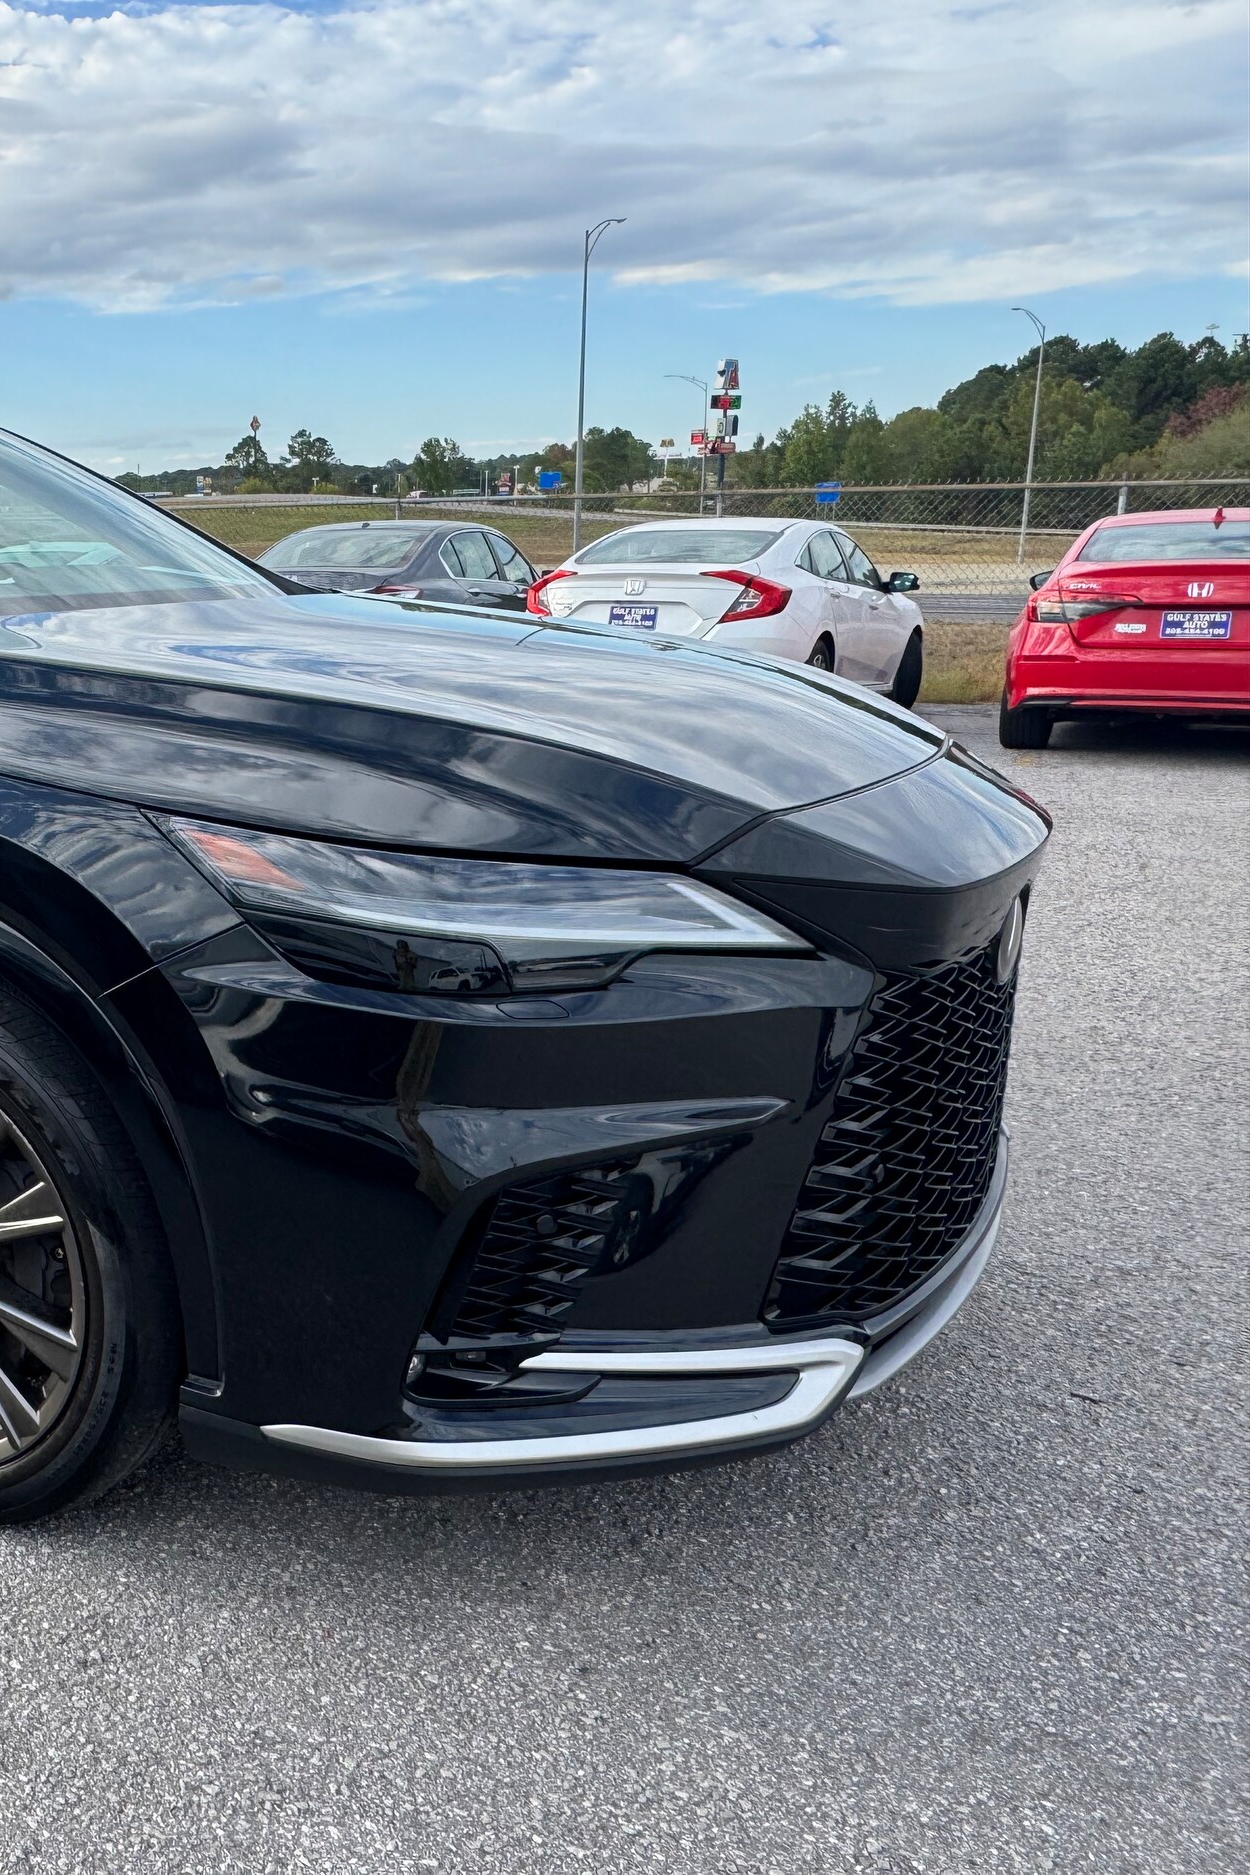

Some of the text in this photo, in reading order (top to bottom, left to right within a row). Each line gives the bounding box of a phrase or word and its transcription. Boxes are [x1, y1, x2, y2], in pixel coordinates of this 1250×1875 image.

[1166, 614, 1227, 622] GULF STATES
[1183, 621, 1208, 629] AUTO
